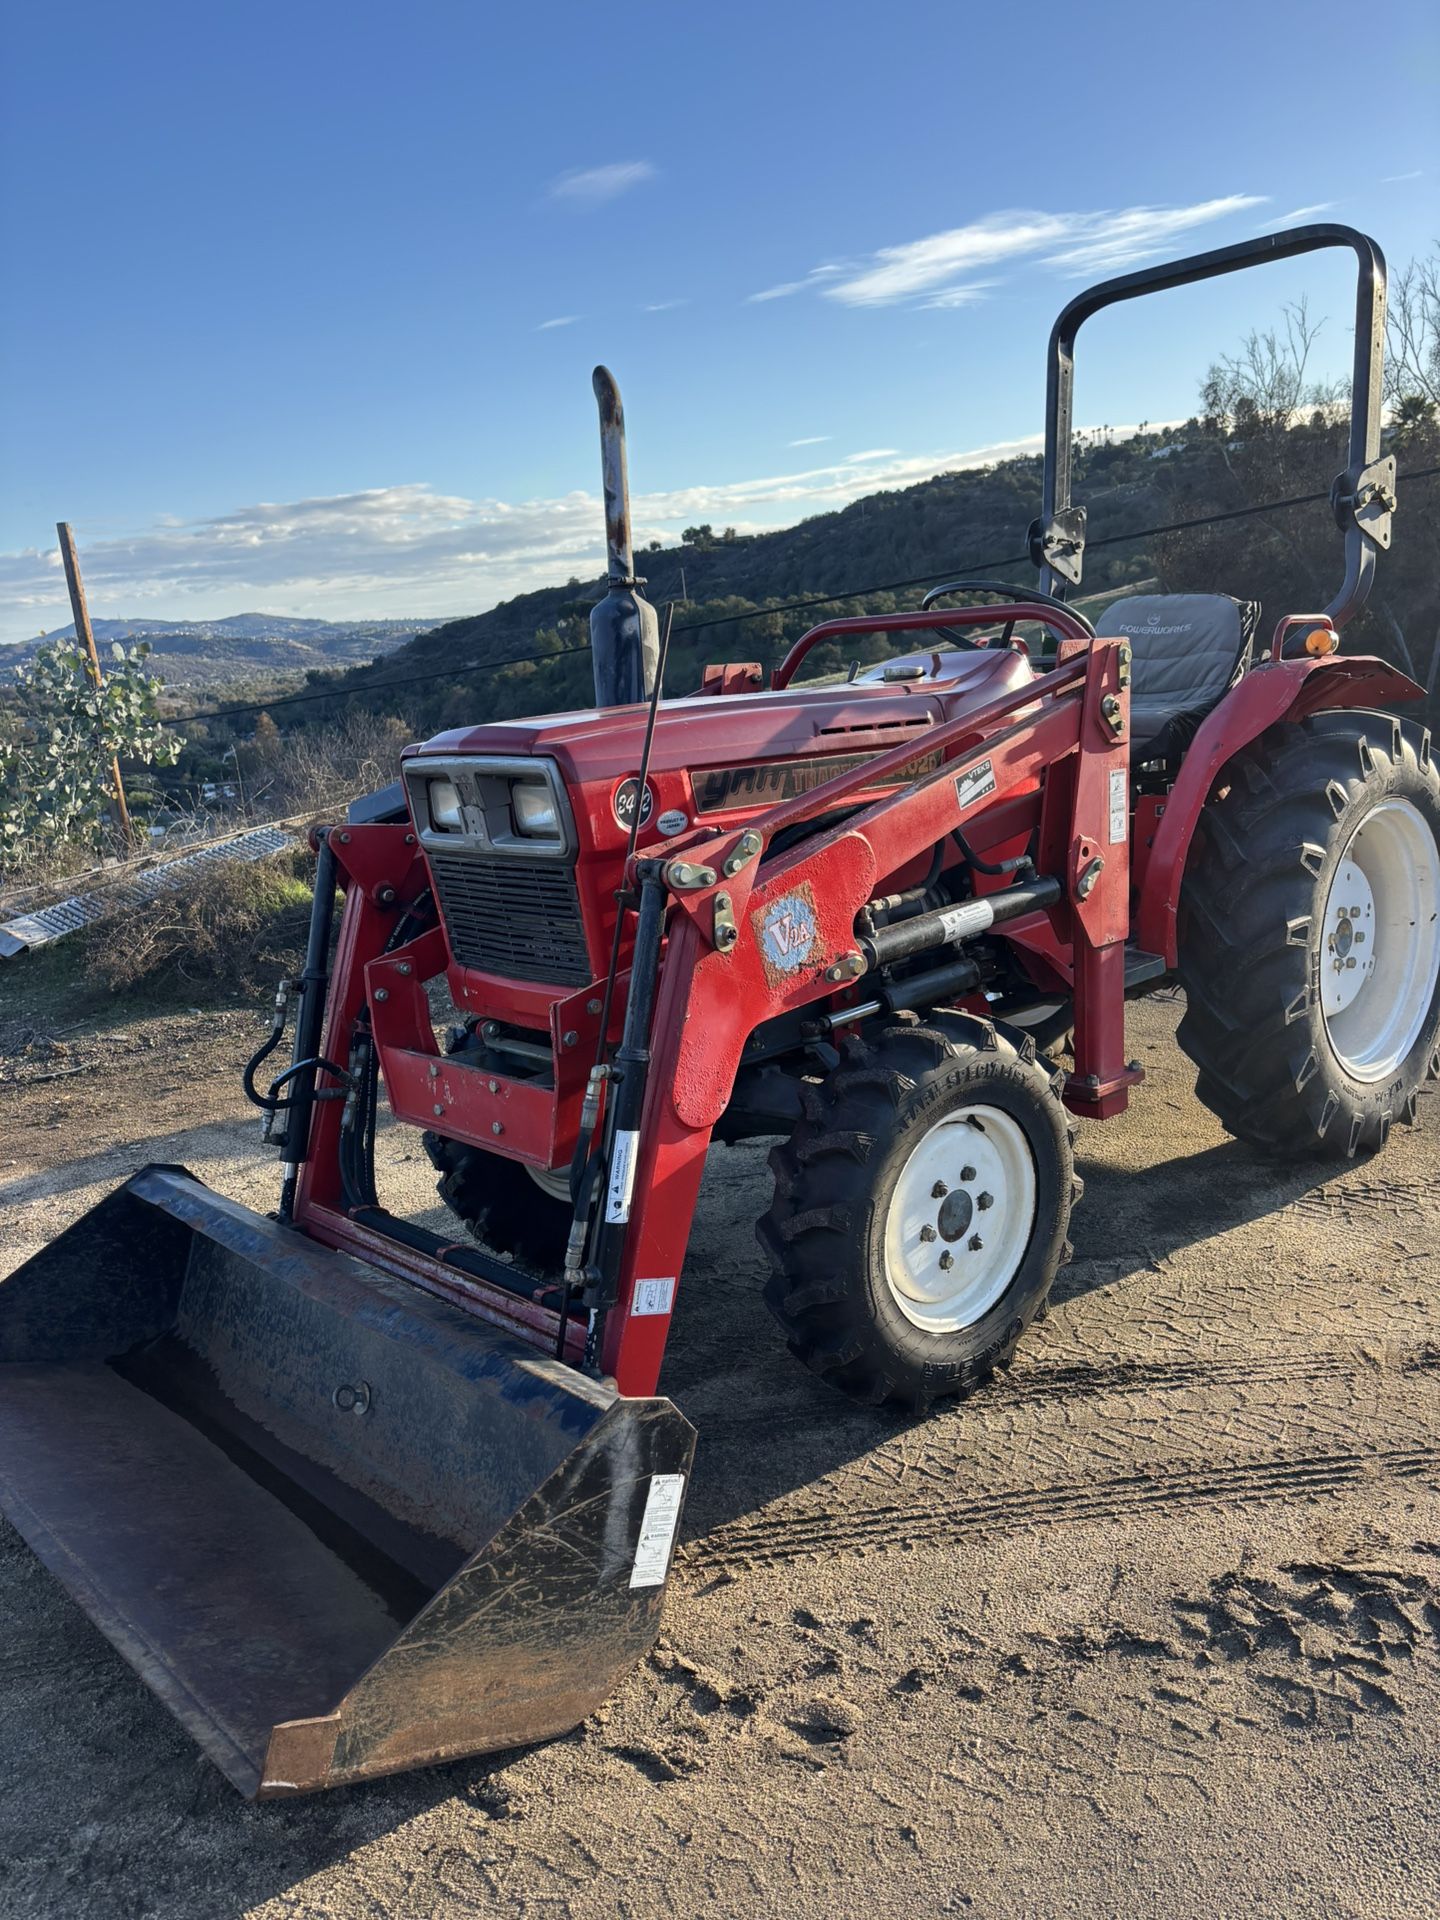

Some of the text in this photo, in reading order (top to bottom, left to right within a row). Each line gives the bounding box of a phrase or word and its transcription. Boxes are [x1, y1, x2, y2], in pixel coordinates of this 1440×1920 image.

[1119, 624, 1192, 635] POWERWORKS
[617, 792, 651, 815] 242
[614, 1149, 623, 1180] WARNING
